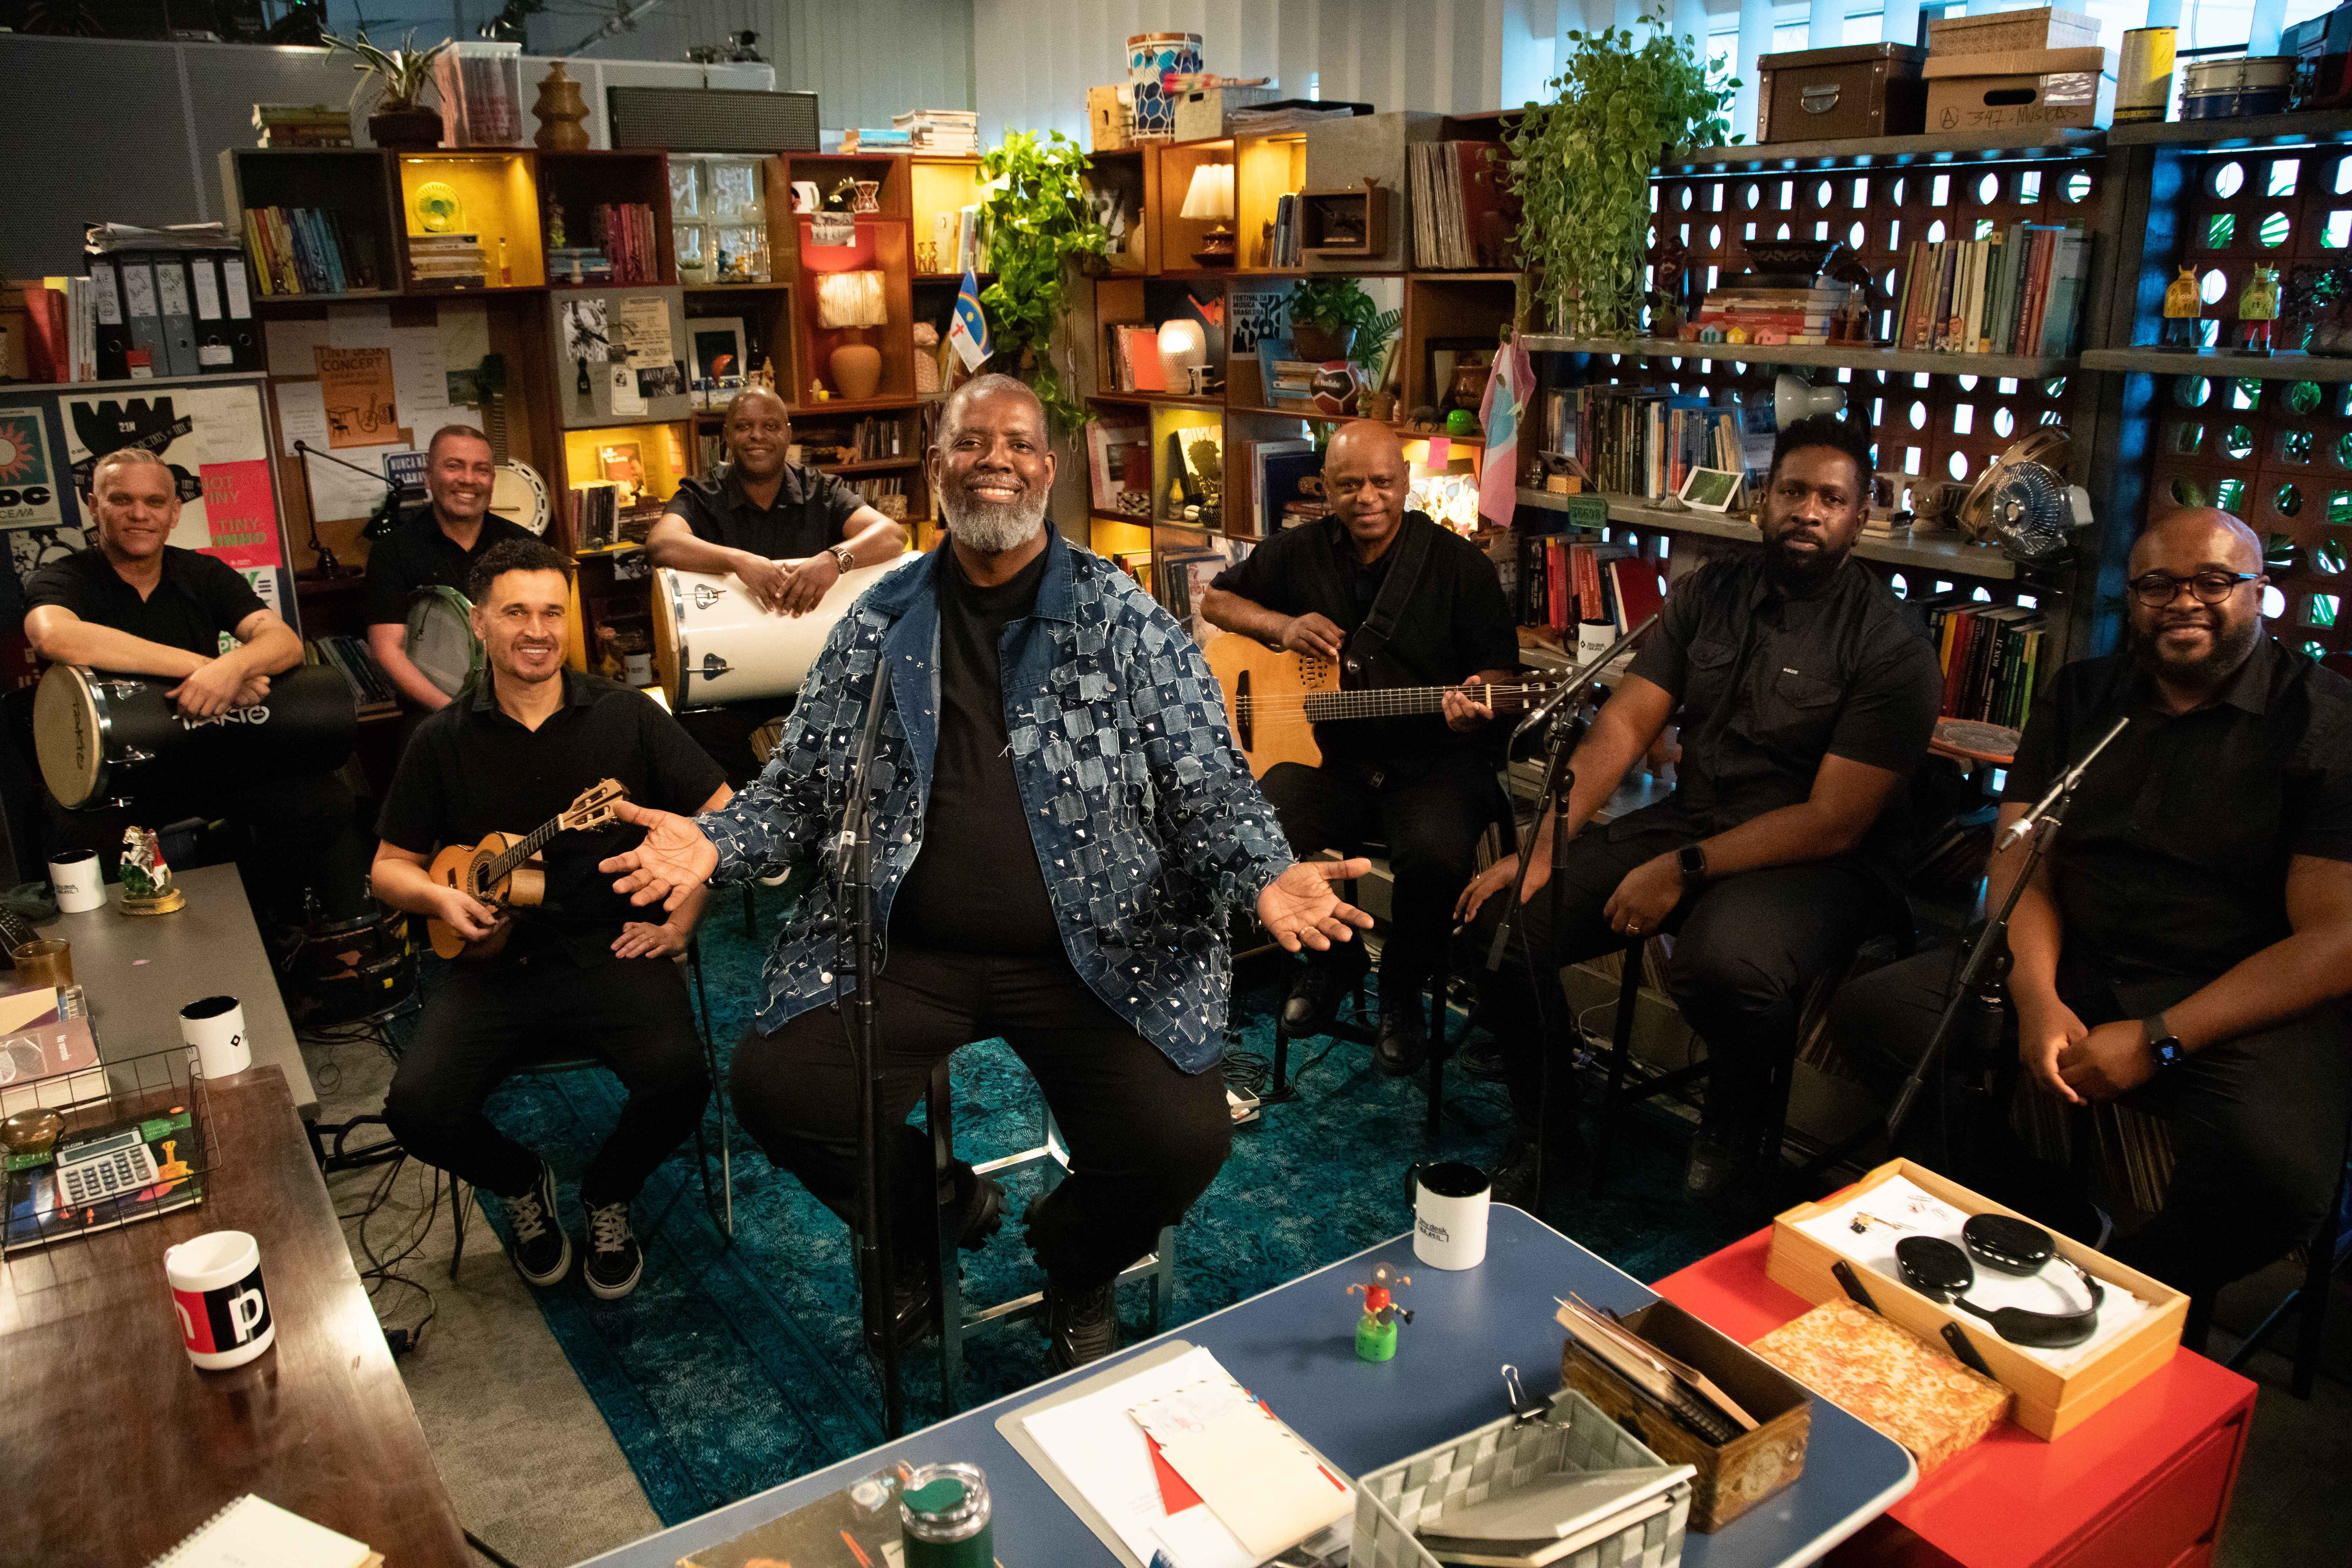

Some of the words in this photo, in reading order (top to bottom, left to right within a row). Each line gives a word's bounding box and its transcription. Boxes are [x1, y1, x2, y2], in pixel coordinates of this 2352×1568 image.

[321, 357, 382, 371] CONCERT
[1320, 379, 1340, 389] YouTube
[1996, 639, 2003, 648] 21
[1992, 650, 2001, 667] BOX
[62, 1141, 84, 1150] ELGIN
[1420, 1226, 1444, 1242] BRASIL
[1430, 1224, 1447, 1234] desk
